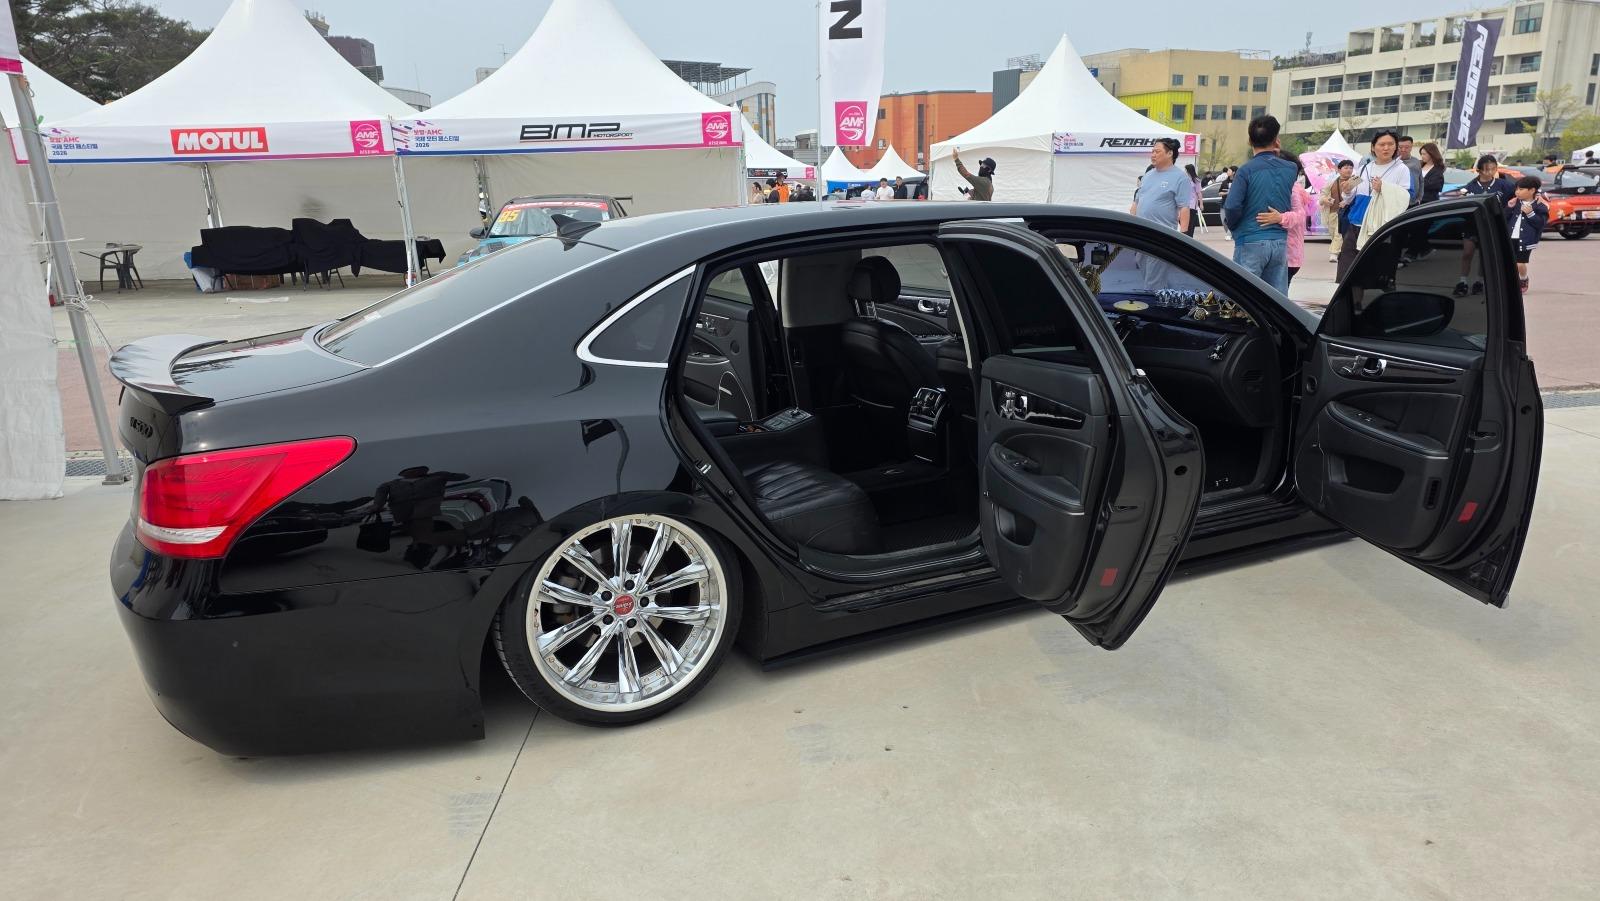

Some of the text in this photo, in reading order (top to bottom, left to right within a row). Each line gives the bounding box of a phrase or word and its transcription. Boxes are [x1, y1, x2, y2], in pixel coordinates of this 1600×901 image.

[706, 122, 728, 130] AMF
[839, 116, 864, 127] AMF
[177, 131, 264, 151] MOTUL
